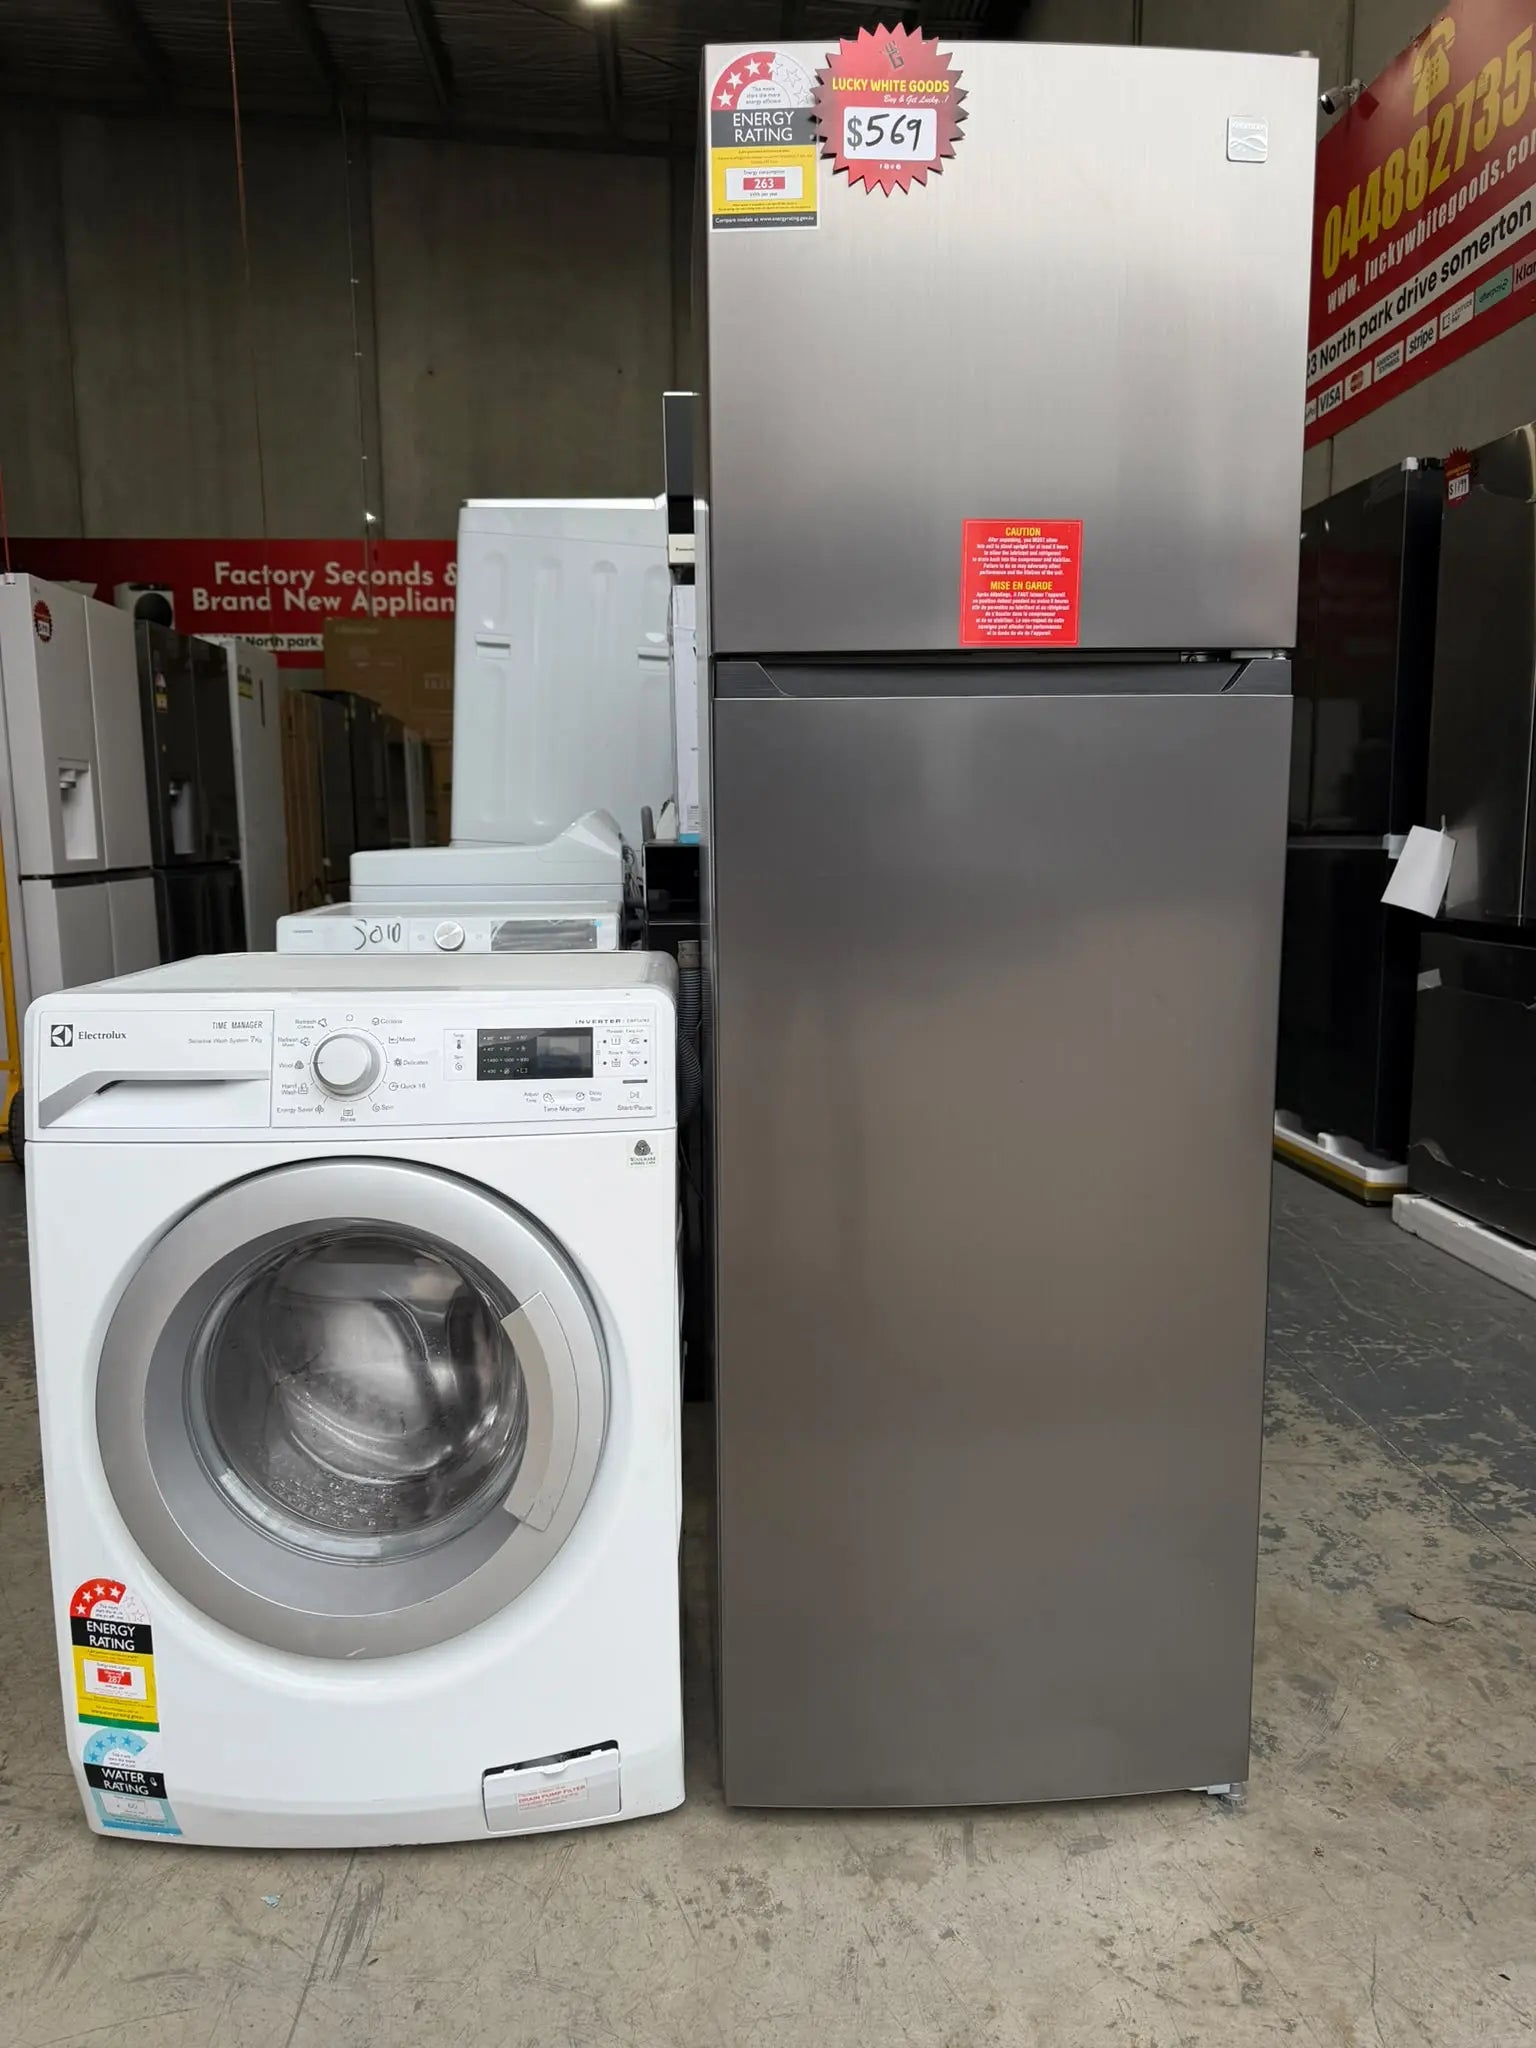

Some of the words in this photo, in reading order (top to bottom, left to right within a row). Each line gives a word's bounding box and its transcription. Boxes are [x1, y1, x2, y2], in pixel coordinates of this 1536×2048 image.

[832, 77, 868, 90] LUCKY
[870, 79, 906, 92] WHITE
[908, 80, 950, 93] GOODS
[884, 95, 897, 104] Buy
[906, 96, 917, 105] Get
[733, 111, 794, 126] ENERGY
[734, 128, 792, 142] RATING
[847, 114, 922, 152] $569
[1322, 23, 1536, 280] 044882735
[754, 178, 774, 189] 263
[1320, 327, 1356, 370] North
[1360, 301, 1393, 349] park
[1397, 271, 1437, 315] drive
[1441, 200, 1531, 283] somerton
[1320, 385, 1340, 412] VISA
[1409, 326, 1434, 354] stripe
[1006, 527, 1040, 536] CAUTION
[214, 561, 315, 590] Factory
[325, 560, 434, 586] Seconds
[990, 581, 1010, 590] MISE
[1013, 581, 1022, 590] EN
[1026, 581, 1052, 590] GARDE
[192, 588, 272, 611] Brand
[284, 588, 342, 611] New
[287, 636, 320, 648] park
[212, 1021, 228, 1029] TIME
[231, 1020, 263, 1029] MANAGER
[78, 1030, 127, 1040] Electrolux
[86, 1620, 136, 1638] ENERGY
[89, 1636, 134, 1651] RATING
[102, 1768, 145, 1784] WATER
[104, 1780, 149, 1795] RATING
[563, 1785, 586, 1794] FILTER
